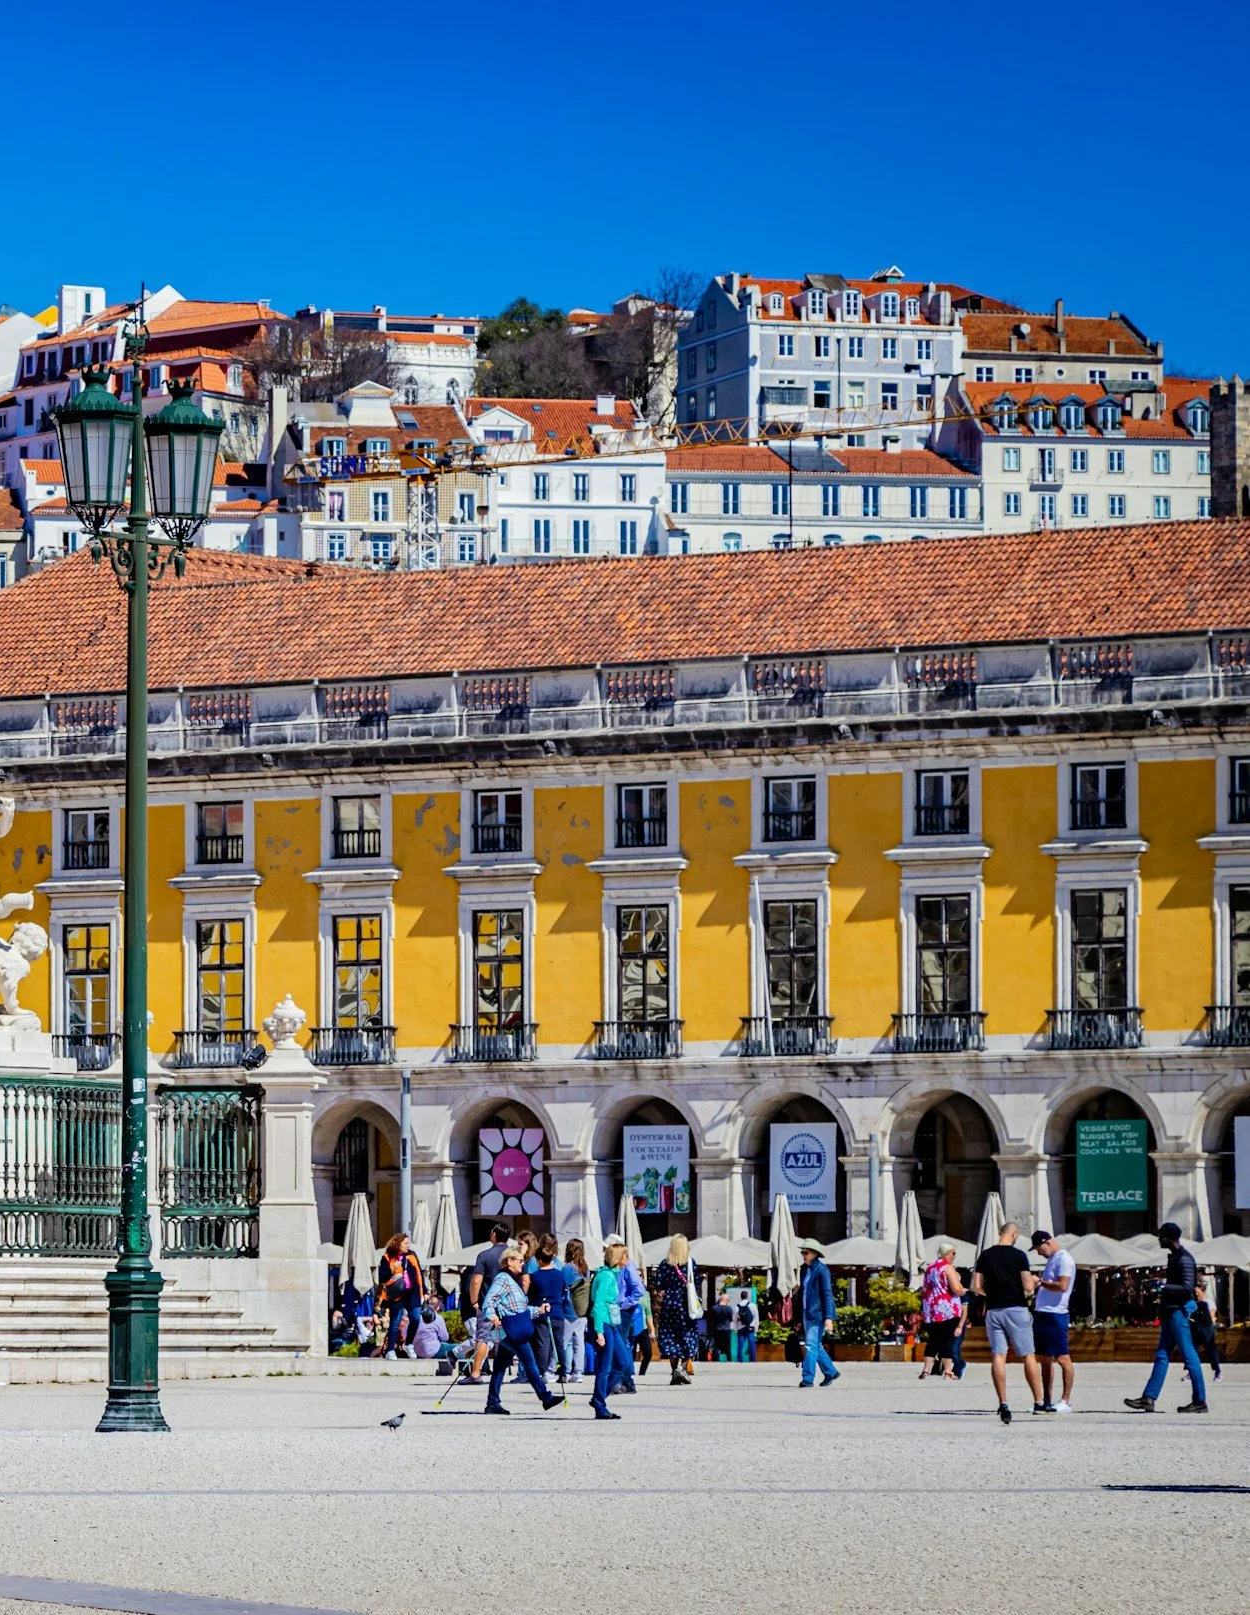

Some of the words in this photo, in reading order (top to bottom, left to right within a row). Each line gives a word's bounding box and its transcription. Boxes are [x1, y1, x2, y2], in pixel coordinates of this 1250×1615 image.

[665, 1133, 683, 1141] BAR
[786, 1153, 821, 1168] AZUL
[1080, 1189, 1143, 1203] TERRACE
